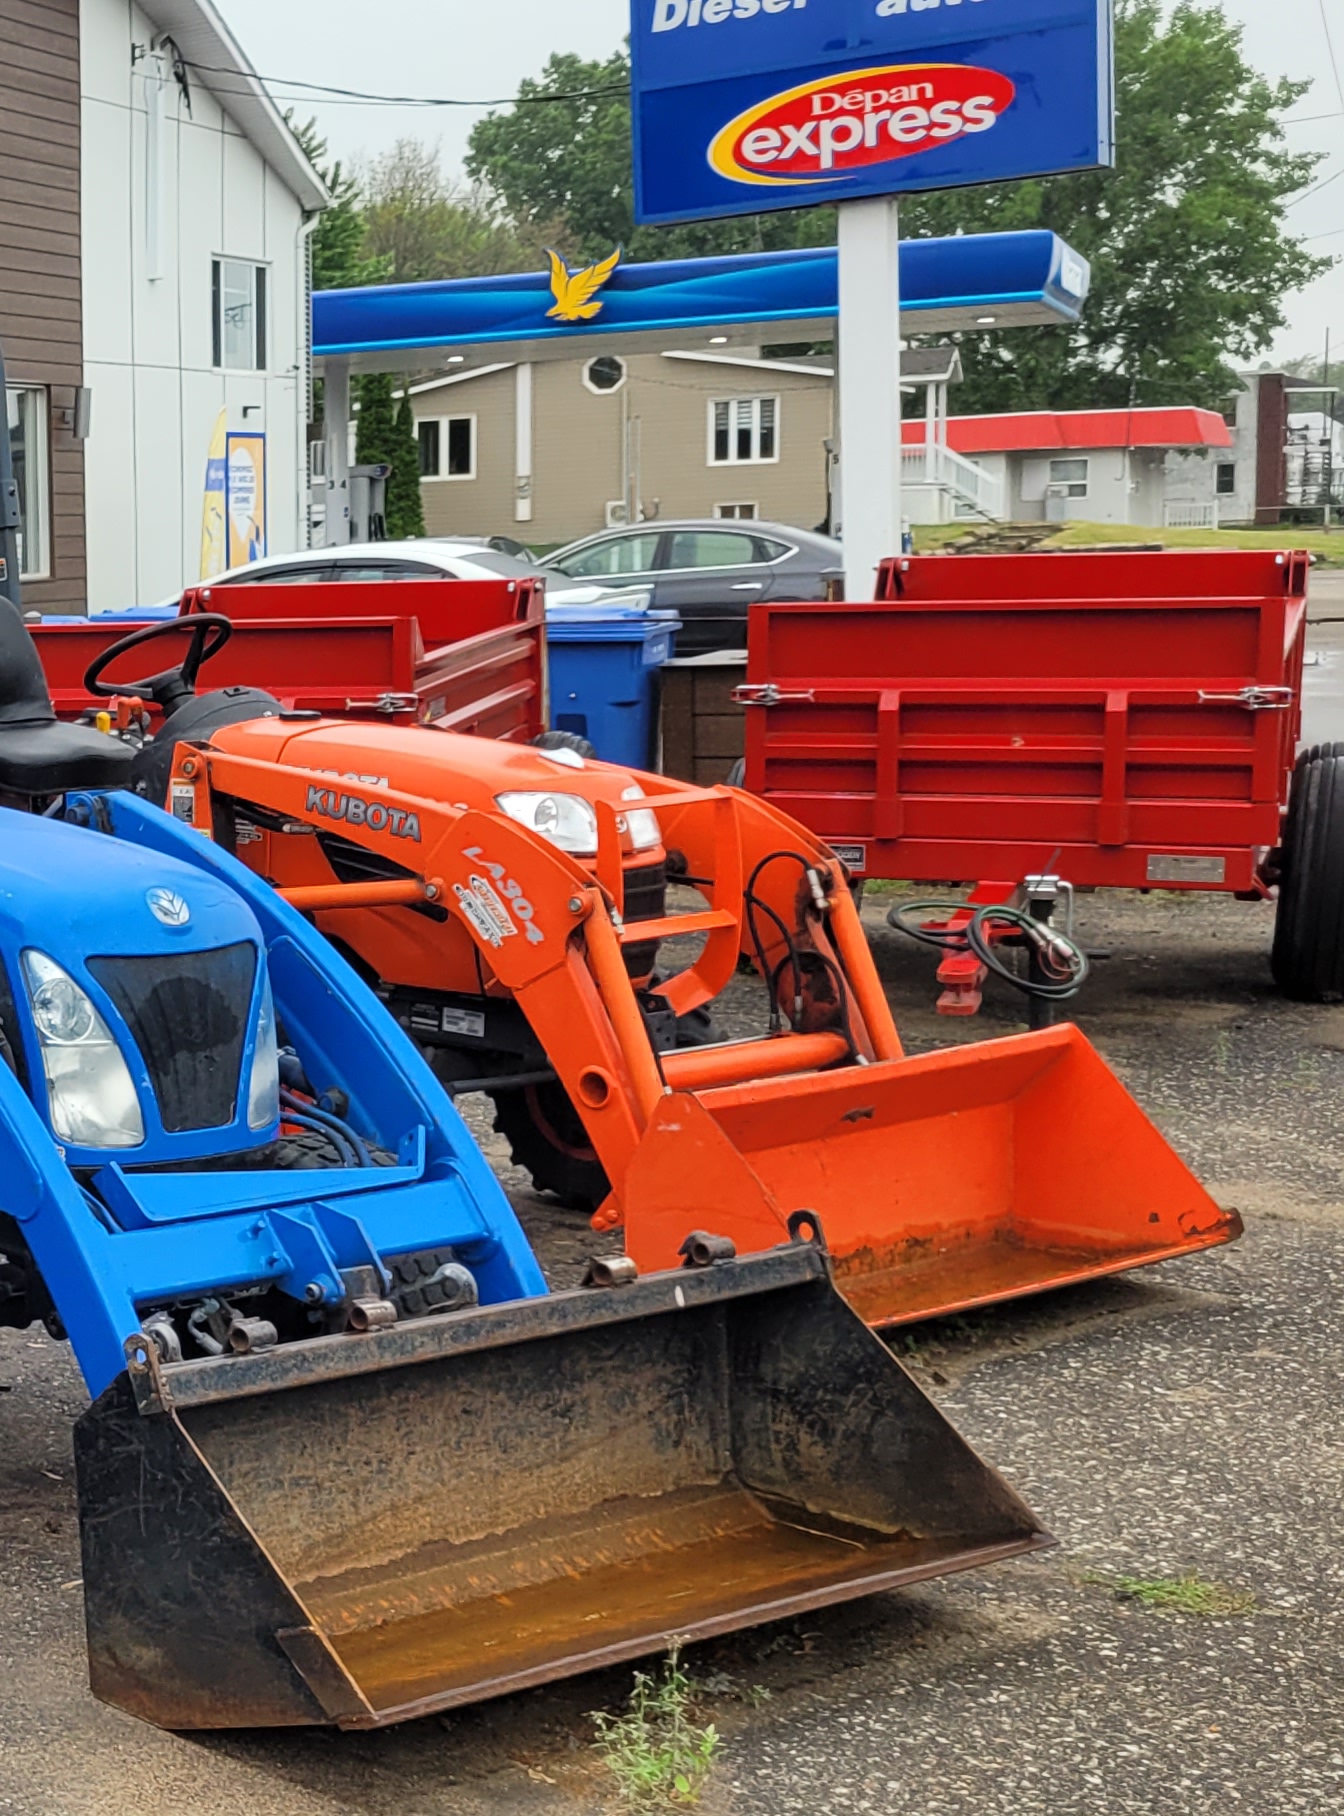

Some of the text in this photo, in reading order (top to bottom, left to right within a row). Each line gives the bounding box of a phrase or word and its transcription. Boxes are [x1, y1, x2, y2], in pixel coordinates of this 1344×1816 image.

[651, 0, 807, 33] Diese
[810, 80, 934, 116] Dépan
[740, 95, 998, 169] express
[305, 784, 422, 842] KUBOTA
[460, 846, 544, 945] LA304
